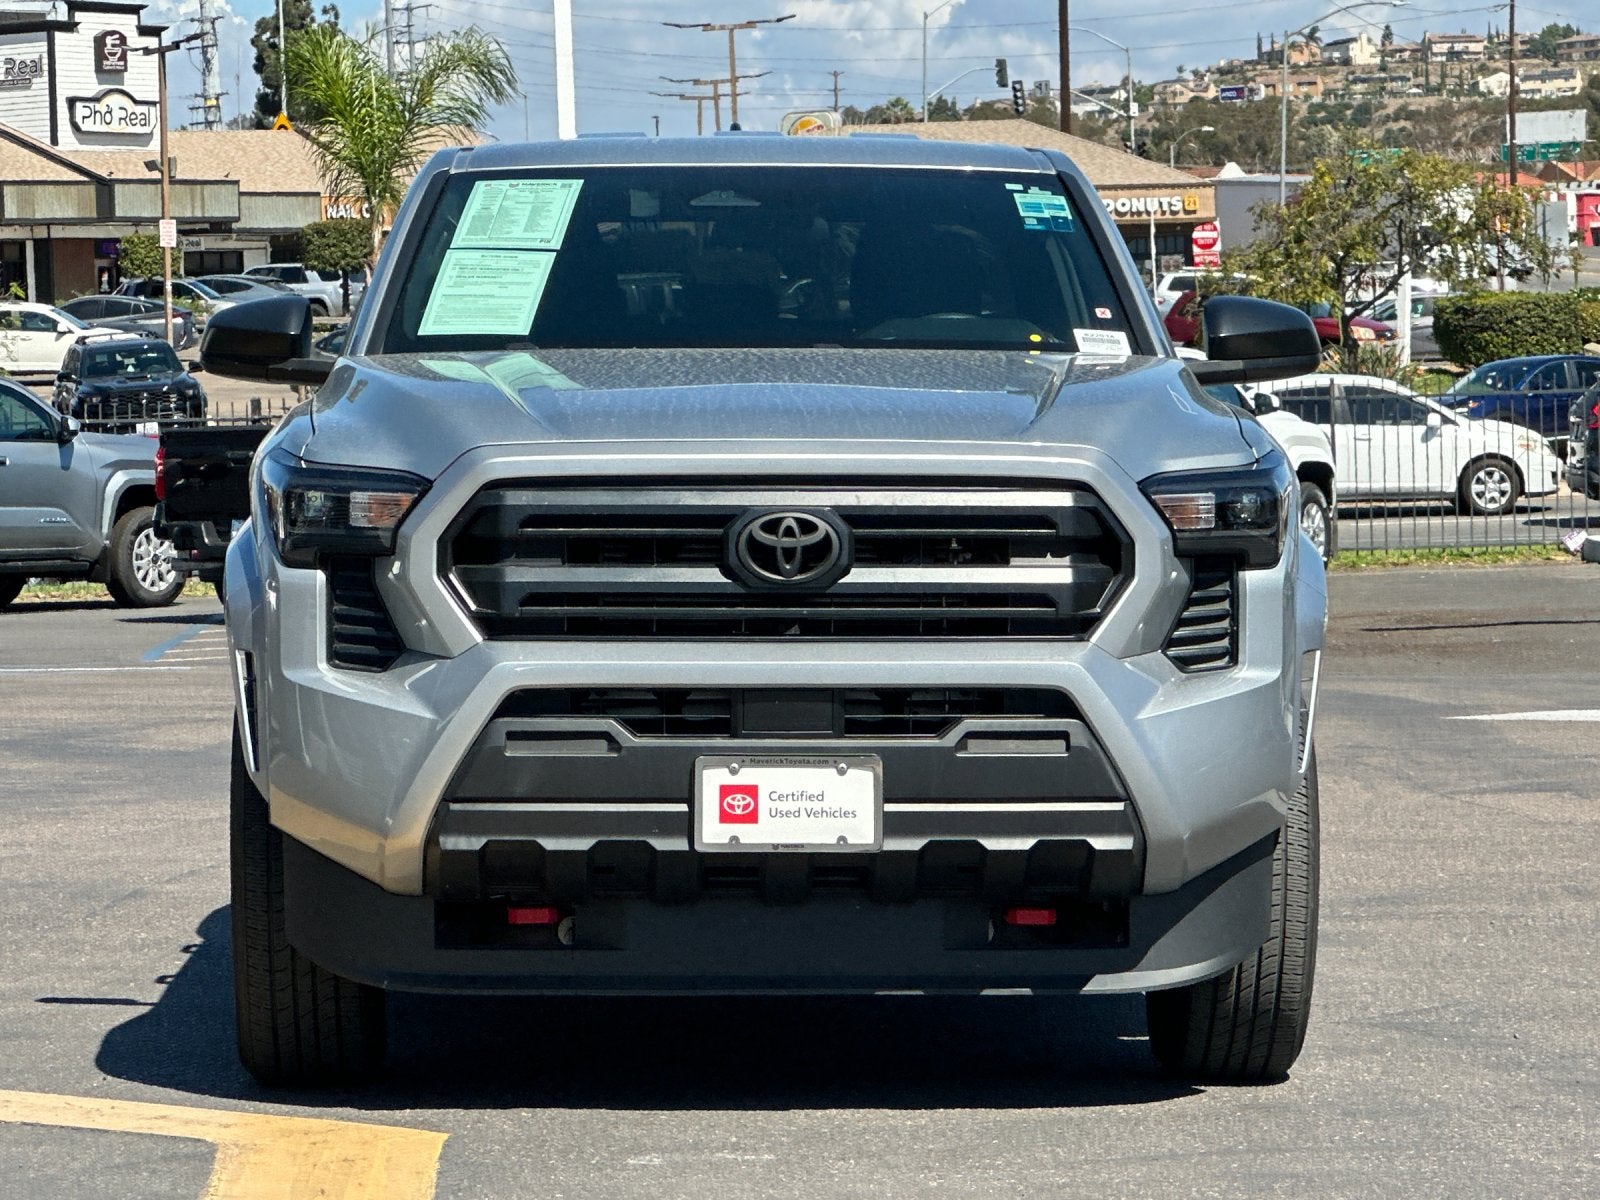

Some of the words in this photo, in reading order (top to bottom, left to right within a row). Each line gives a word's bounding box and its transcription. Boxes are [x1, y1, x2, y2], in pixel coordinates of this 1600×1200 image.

[4, 53, 43, 77] Real
[118, 106, 151, 128] Real
[1102, 196, 1183, 212] DONUTS
[768, 790, 825, 802] Certified
[769, 807, 801, 818] Used
[804, 807, 857, 818] Vehicles
